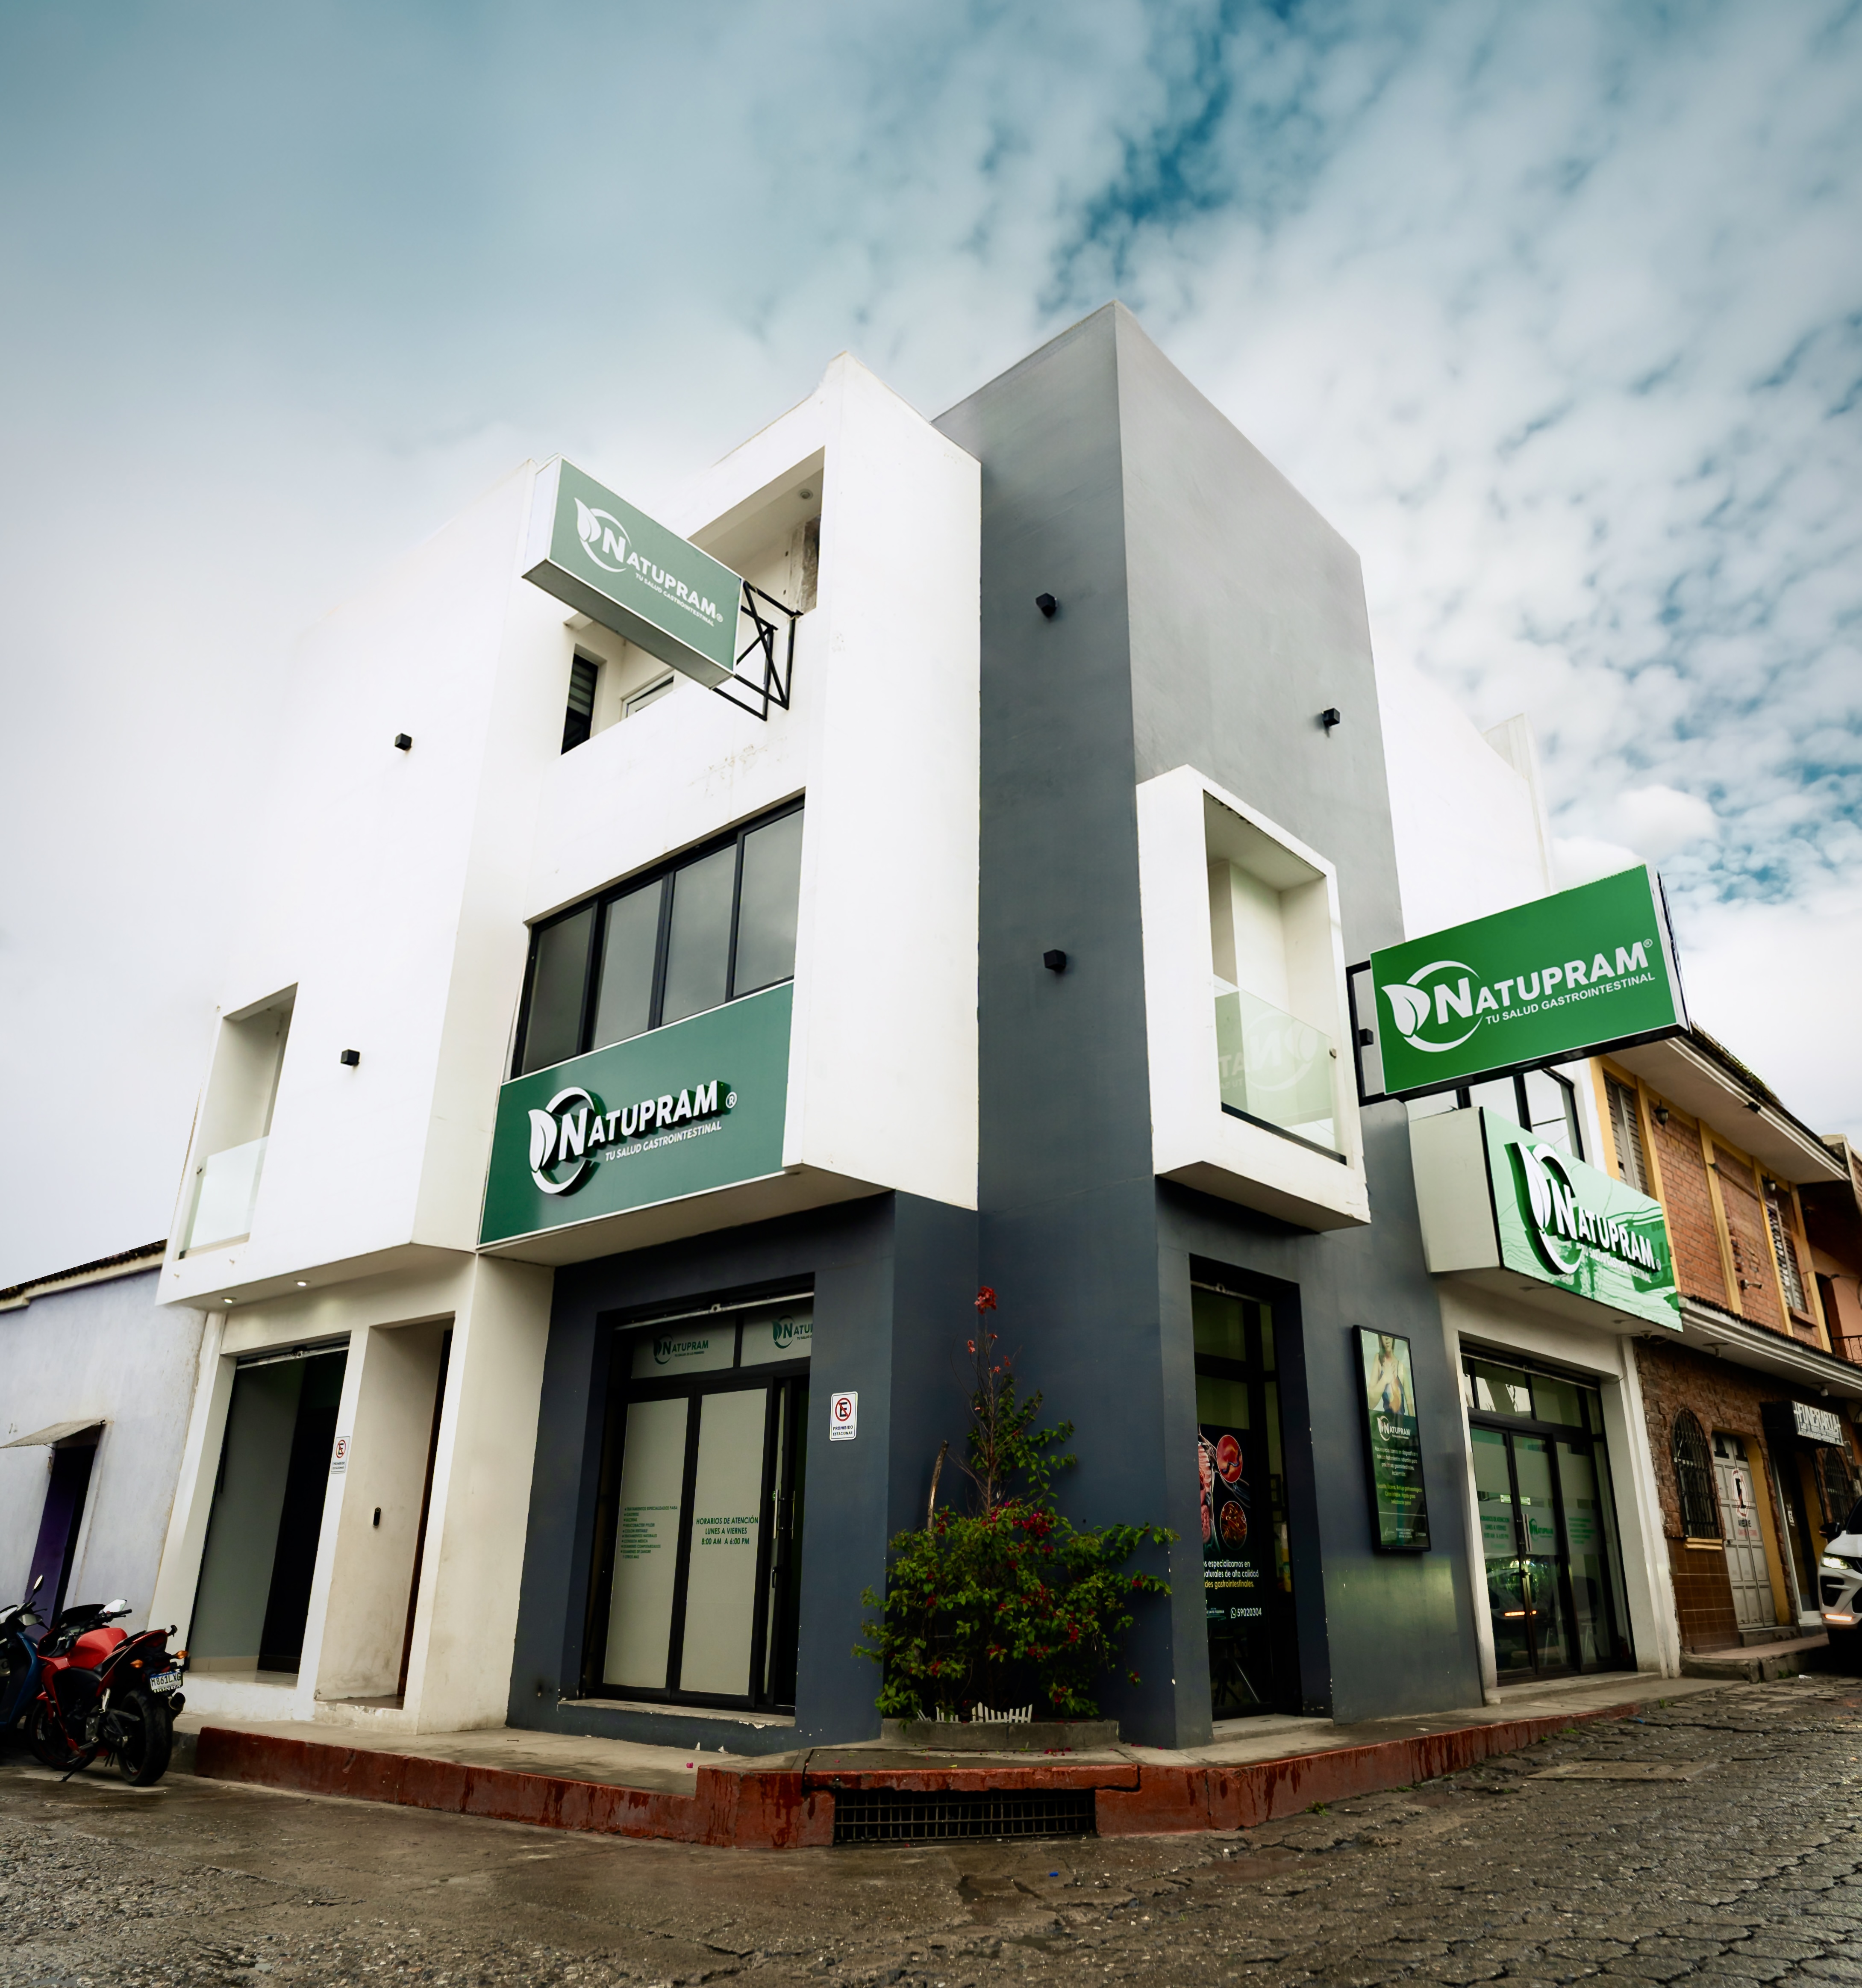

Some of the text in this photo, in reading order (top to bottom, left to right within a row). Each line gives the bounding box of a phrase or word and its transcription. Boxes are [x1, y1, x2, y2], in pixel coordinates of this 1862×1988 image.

[602, 527, 716, 619] NATUPRAM
[635, 572, 714, 627] TU SALUD GASTROINTESTINAL
[1434, 941, 1648, 1024] NATUPRAM
[1485, 972, 1655, 1025] TU SALUD GASTROINTESTINAL
[558, 1080, 718, 1161] NATUPRAM
[605, 1121, 722, 1161] TU SALUD GASTROINTESTINAL
[1550, 1177, 1655, 1270] NATUPRAM
[663, 1340, 709, 1355] NATUPRAM
[1384, 1422, 1411, 1436] NATUPRAM
[731, 1515, 758, 1524] ATENCIÓN
[1208, 1560, 1243, 1569] especializamos
[1215, 1580, 1255, 1589] gastrointestinales.
[1237, 1608, 1262, 1617] 59020304
[154, 1685, 181, 1693] HONDA
